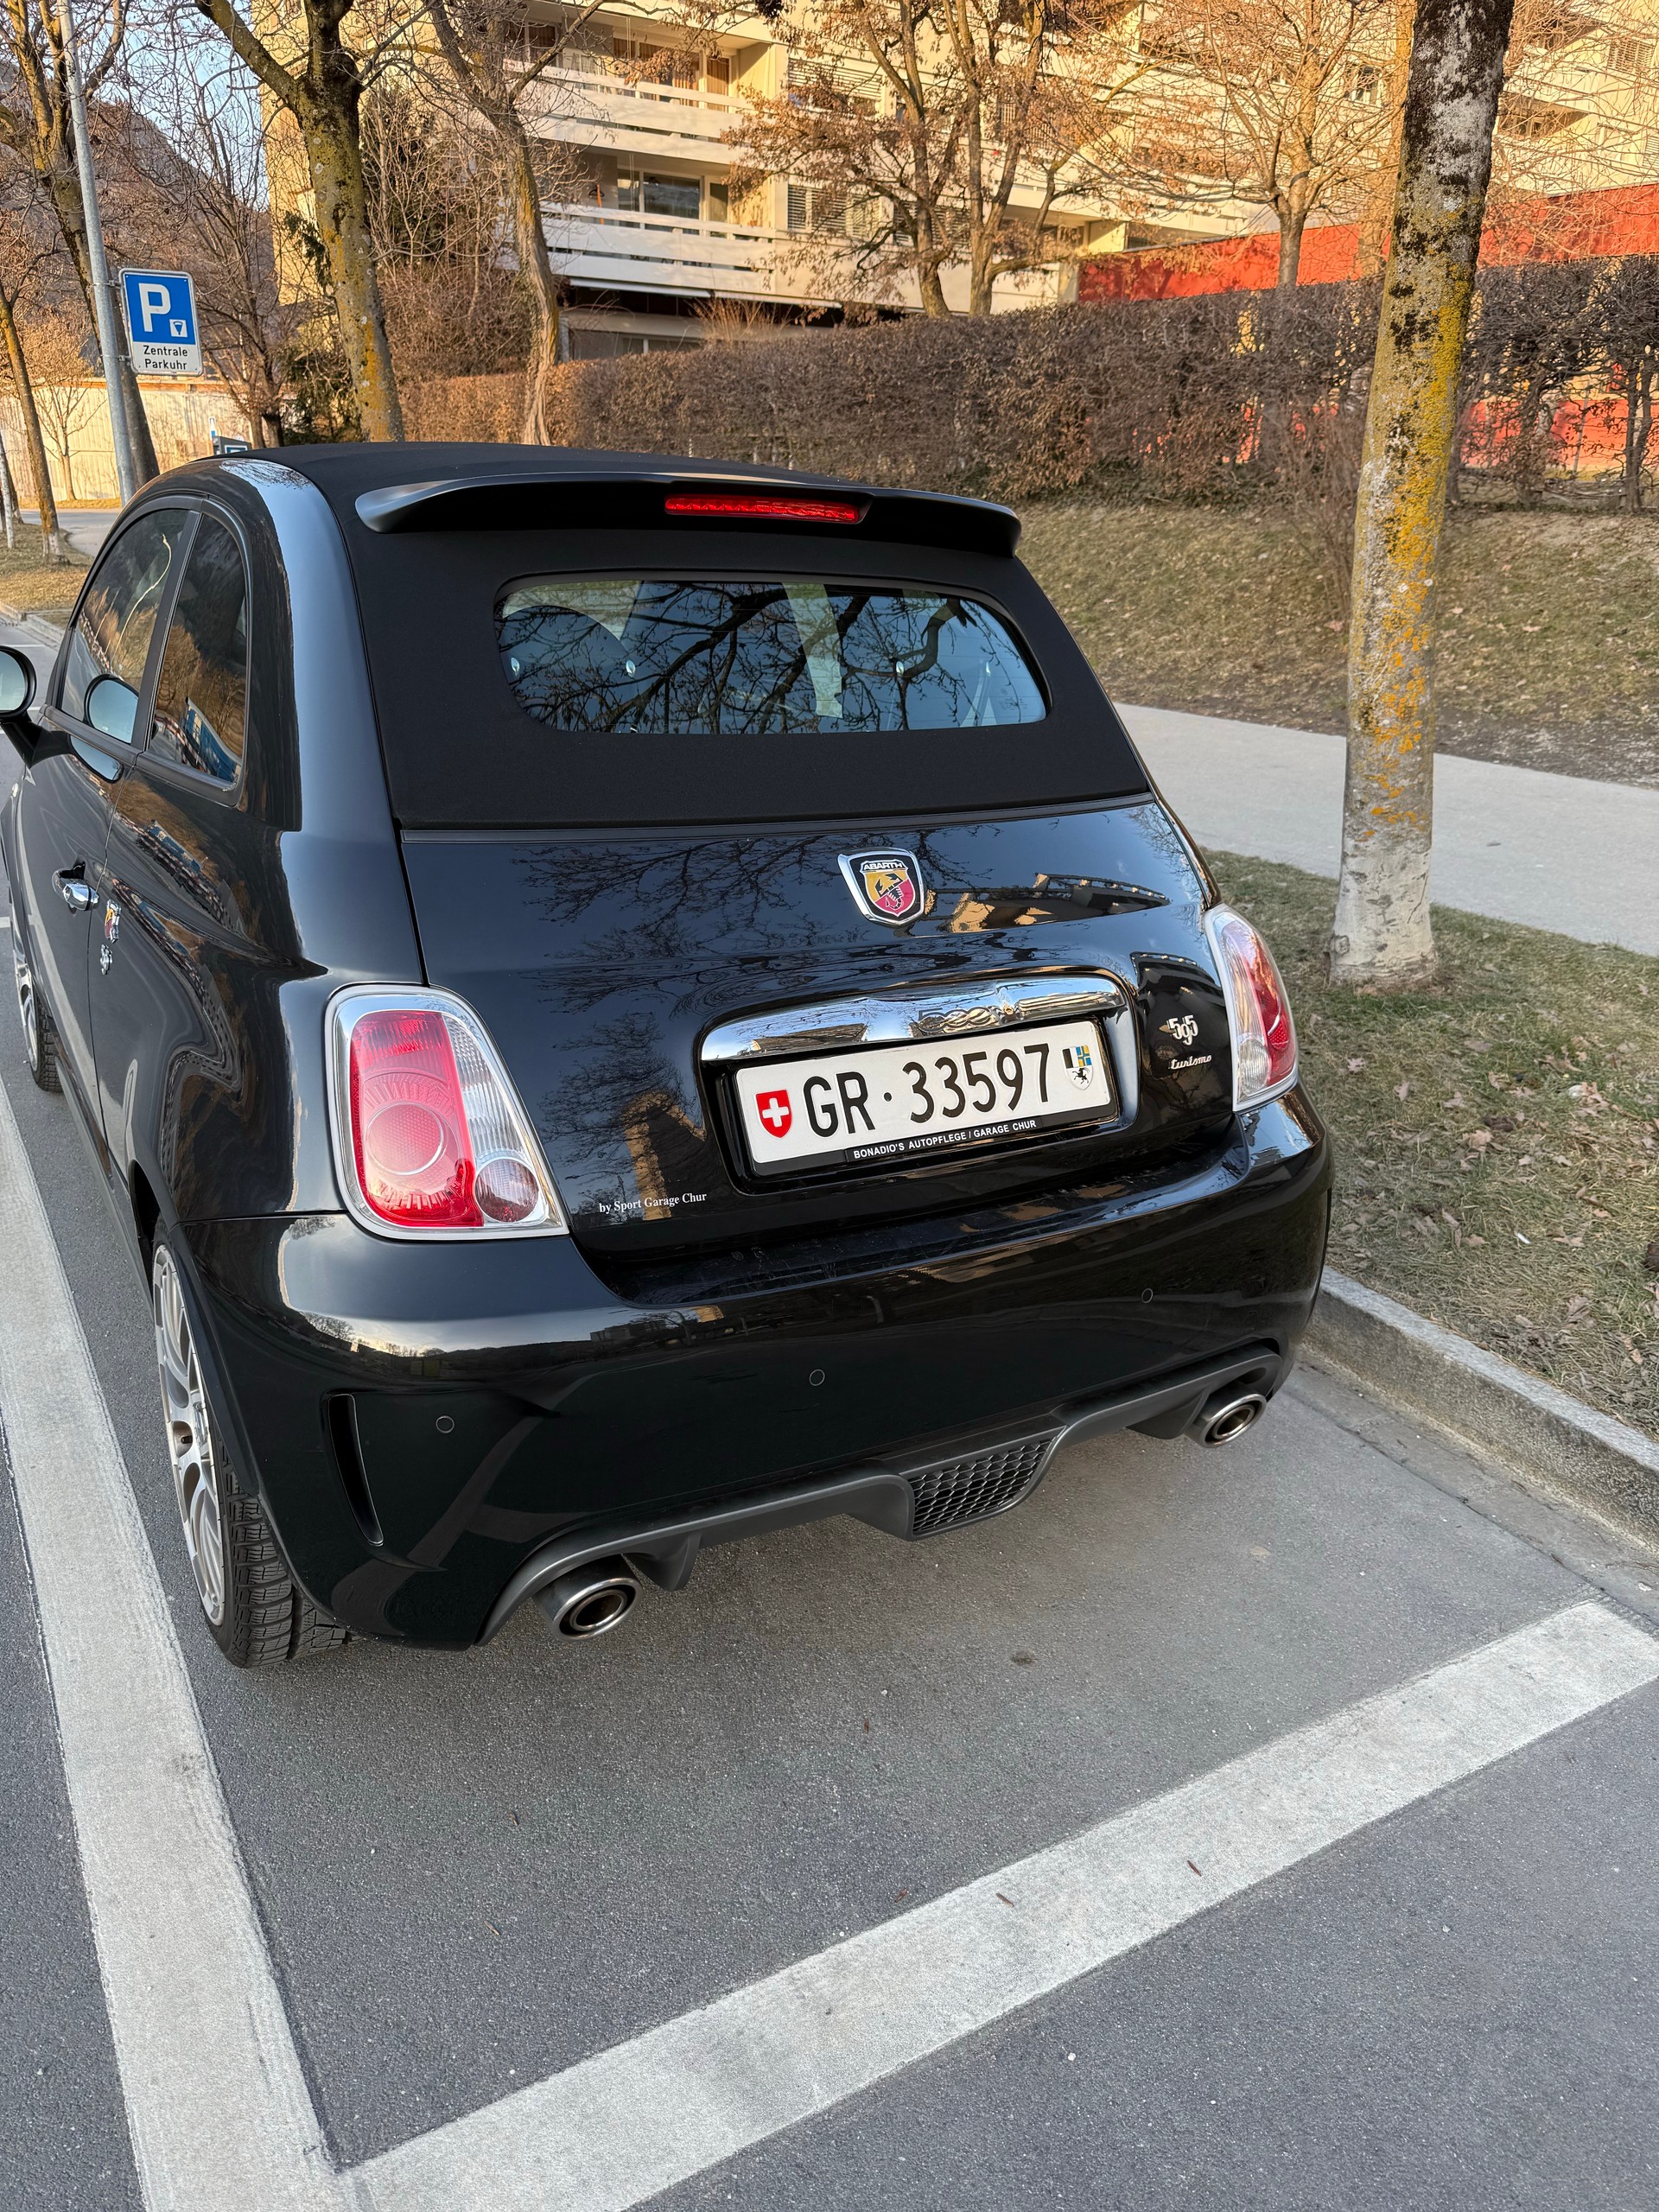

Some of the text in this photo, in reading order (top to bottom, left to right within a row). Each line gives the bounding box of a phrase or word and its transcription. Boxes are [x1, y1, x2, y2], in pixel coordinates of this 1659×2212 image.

[139, 283, 171, 333] P
[143, 345, 188, 357] Zentrale
[144, 358, 188, 371] Parkuhr
[1166, 1014, 1198, 1046] 595
[1170, 1055, 1212, 1070] turismo
[902, 1043, 1050, 1124] 33597
[853, 1142, 906, 1160] BONADIO'S
[908, 1132, 967, 1149] AUTOPFLEGE
[974, 1124, 1009, 1138] GARAGE
[1013, 1120, 1037, 1132] CHUR
[599, 1192, 707, 1215] by Sport Garage Chur
